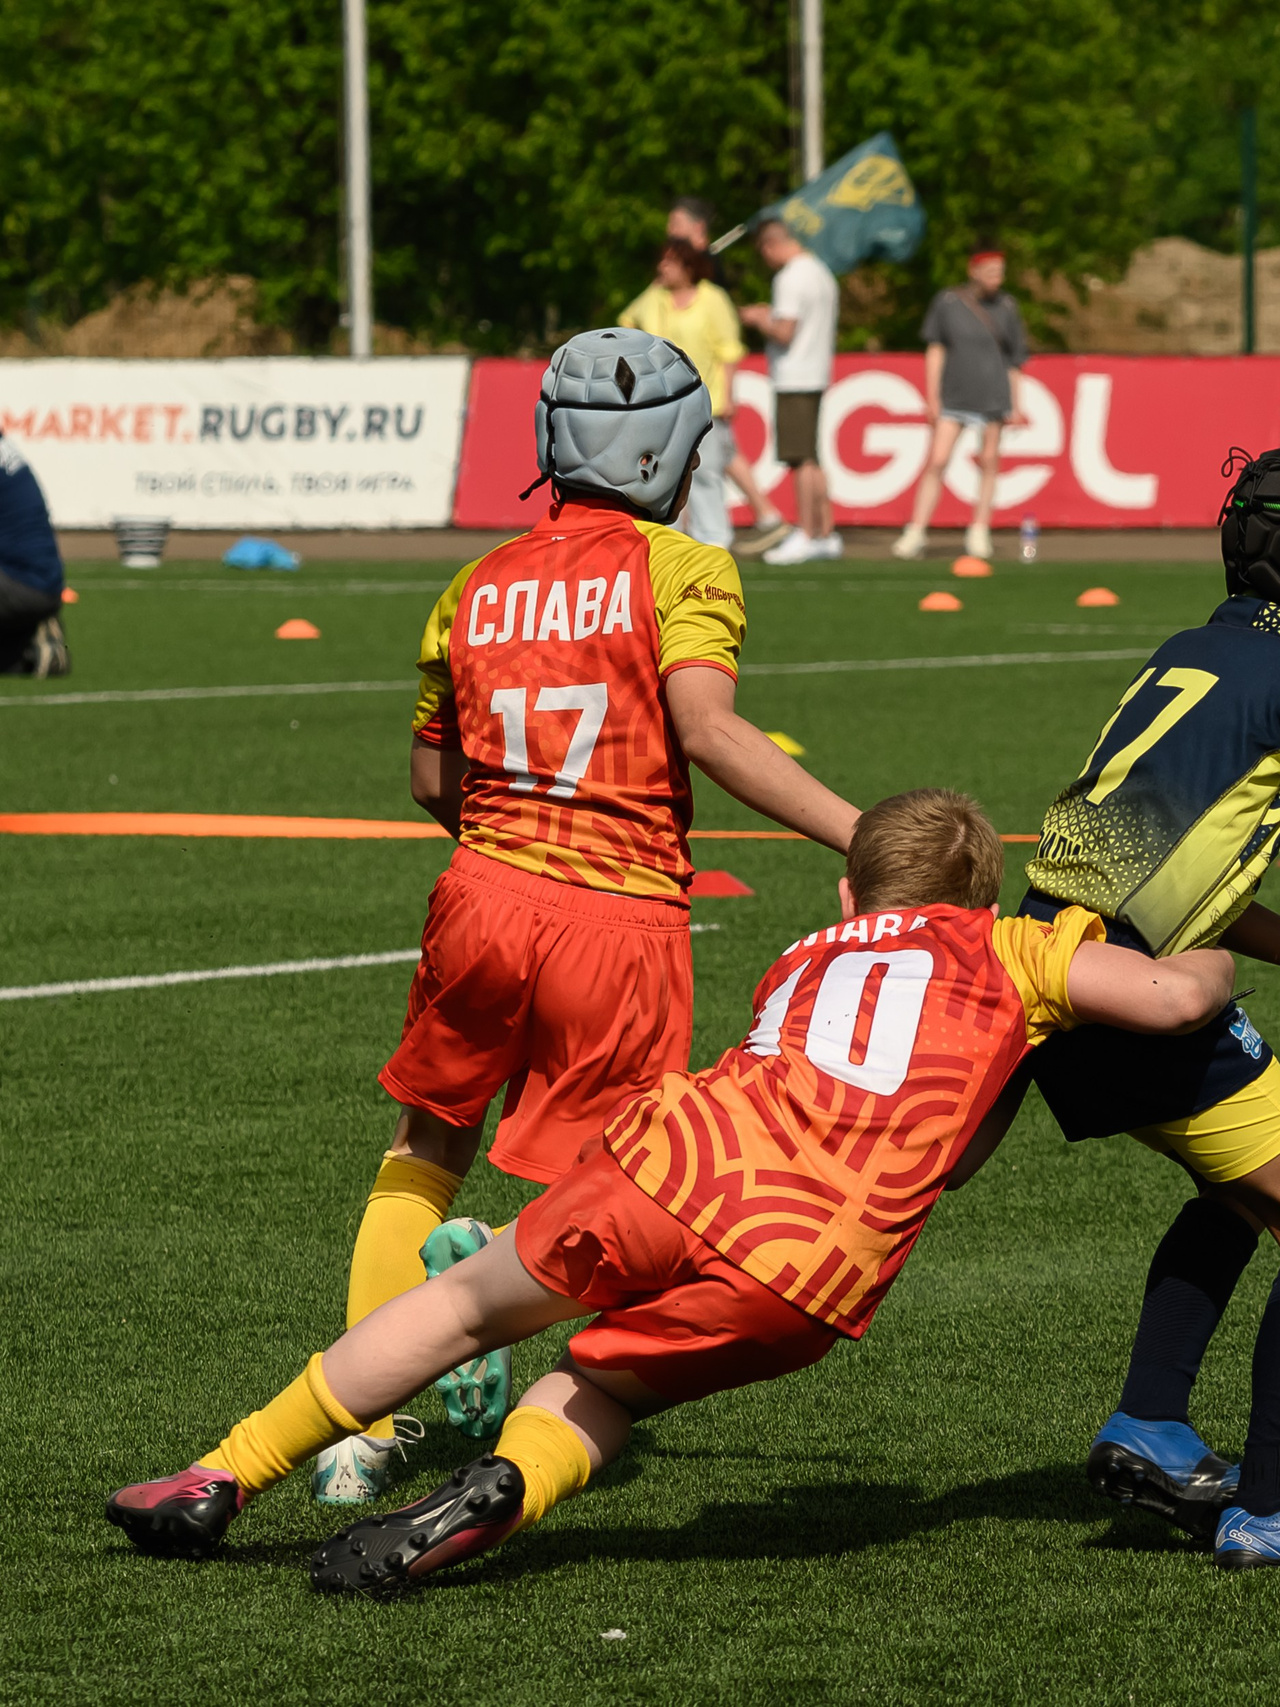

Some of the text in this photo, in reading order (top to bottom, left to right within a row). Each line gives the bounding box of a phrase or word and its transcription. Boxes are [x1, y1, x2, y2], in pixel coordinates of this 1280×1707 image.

[1, 402, 424, 443] MARKET.RUGBY.RU
[467, 570, 634, 647] СЛАВА
[489, 682, 609, 799] 17
[743, 949, 934, 1097] 10
[1228, 1528, 1253, 1545] GSD
